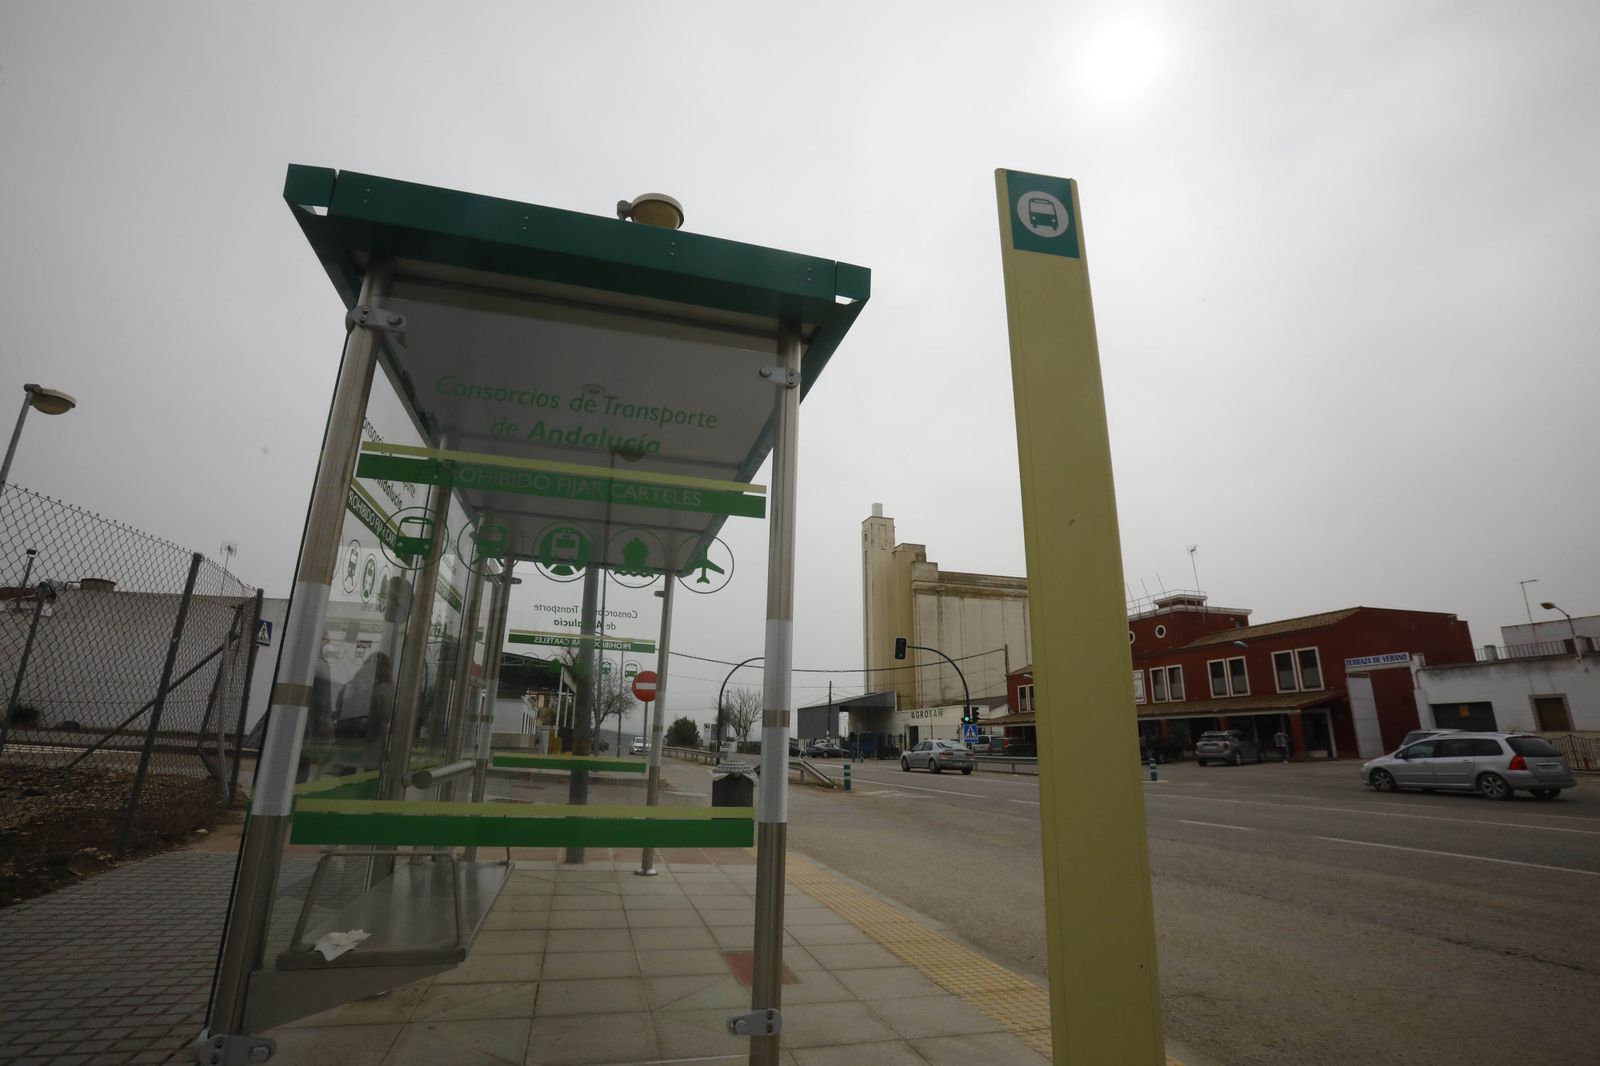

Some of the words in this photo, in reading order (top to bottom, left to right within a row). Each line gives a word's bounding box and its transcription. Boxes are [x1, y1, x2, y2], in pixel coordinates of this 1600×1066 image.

[436, 375, 561, 409] Consorcios
[569, 393, 597, 414] de
[603, 395, 719, 429] Transporte
[490, 416, 519, 438] de
[527, 420, 662, 455] Andalucía
[557, 476, 602, 499] FIJAR
[611, 482, 702, 507] CARTELES
[1372, 656, 1381, 664] DE
[1382, 654, 1408, 662] VERANO
[911, 708, 943, 719] AGROSAN
